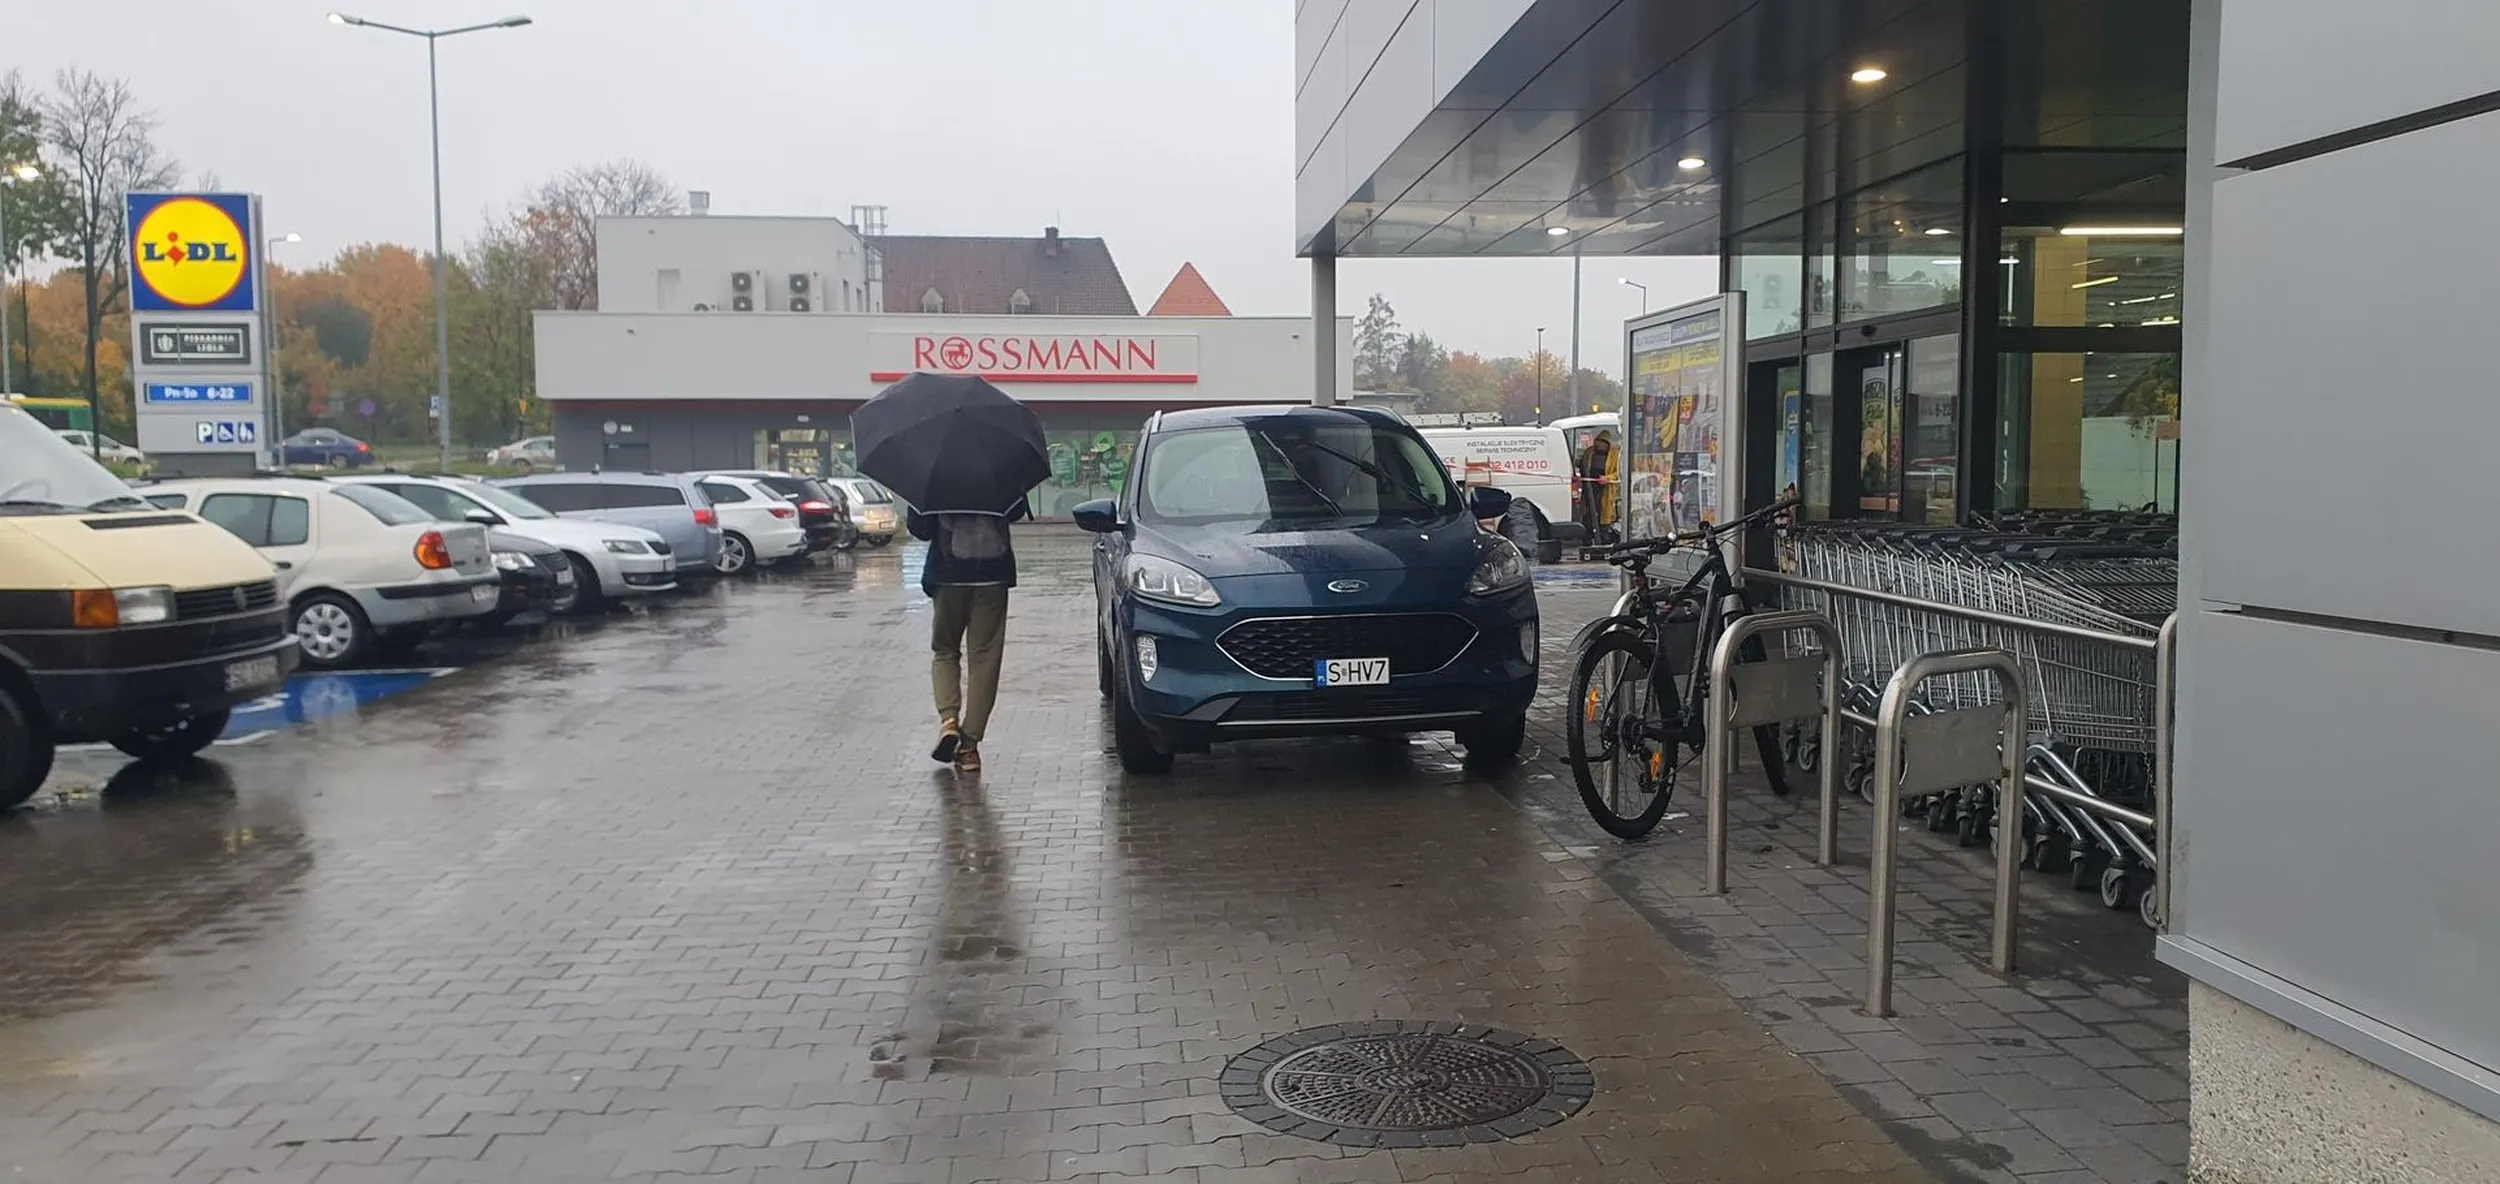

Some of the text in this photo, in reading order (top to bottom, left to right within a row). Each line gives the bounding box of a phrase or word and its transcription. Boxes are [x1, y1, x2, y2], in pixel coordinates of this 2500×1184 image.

[914, 336, 1156, 370] ROSSMANN
[1505, 460, 1525, 469] 412
[1527, 460, 1548, 469] 010
